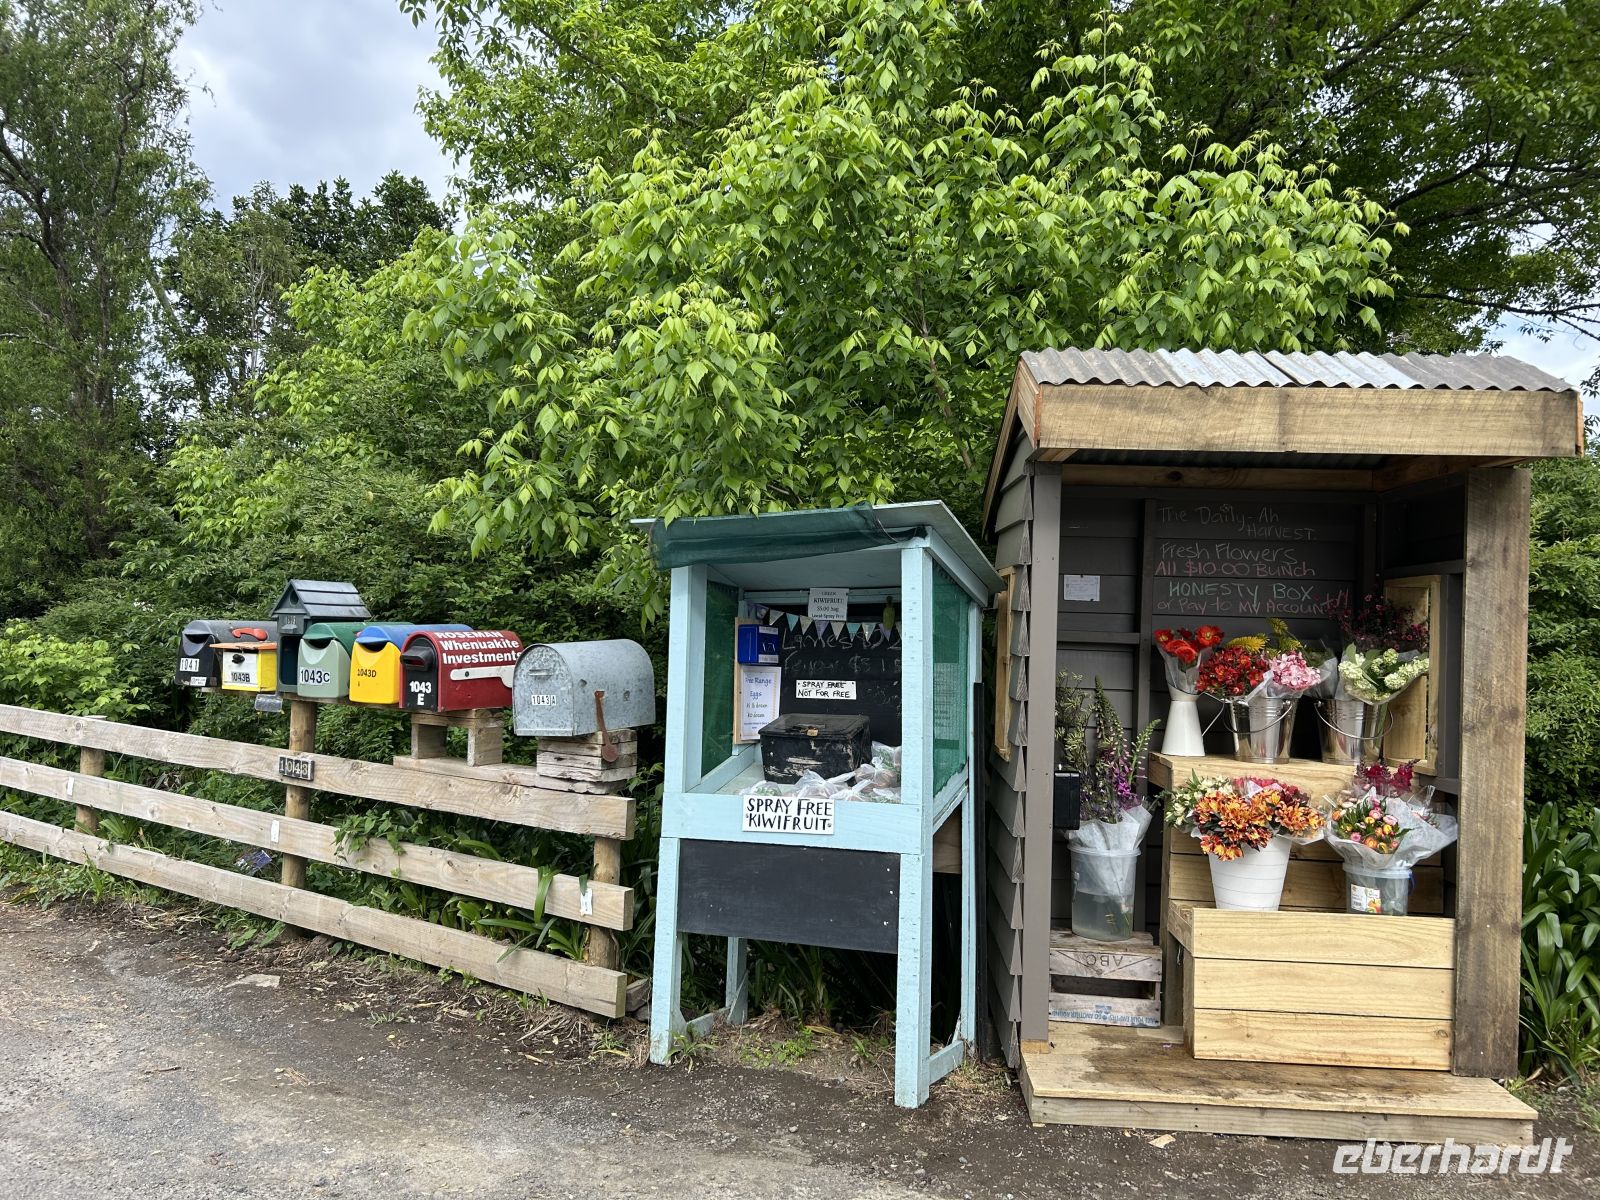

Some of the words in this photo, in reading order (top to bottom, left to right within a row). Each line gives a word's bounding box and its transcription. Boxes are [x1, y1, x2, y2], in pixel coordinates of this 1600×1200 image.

[1158, 507, 1189, 523] The
[1159, 542, 1210, 559] Fresh
[1215, 543, 1298, 566] Flowers
[1169, 582, 1259, 606] HONESTY
[1272, 583, 1314, 600] BOX
[1157, 601, 1173, 610] or
[1211, 597, 1232, 611] to
[439, 638, 520, 651] Whenuakite
[231, 672, 251, 683] 1043B
[300, 669, 330, 683] 1043C
[357, 668, 377, 678] 1043D
[409, 681, 432, 693] 1043
[754, 677, 772, 687] Range
[802, 681, 825, 689] SPRAY
[417, 693, 425, 705] E
[749, 691, 763, 700] Eggs
[797, 689, 812, 698] NOT
[815, 689, 830, 698] FOR
[832, 690, 850, 699] FREE
[280, 759, 308, 776] 1043
[747, 797, 793, 815] SPRAY
[797, 798, 833, 817] FREE
[748, 812, 830, 831] KIWIFRUIT
[1086, 954, 1123, 967] ABC
